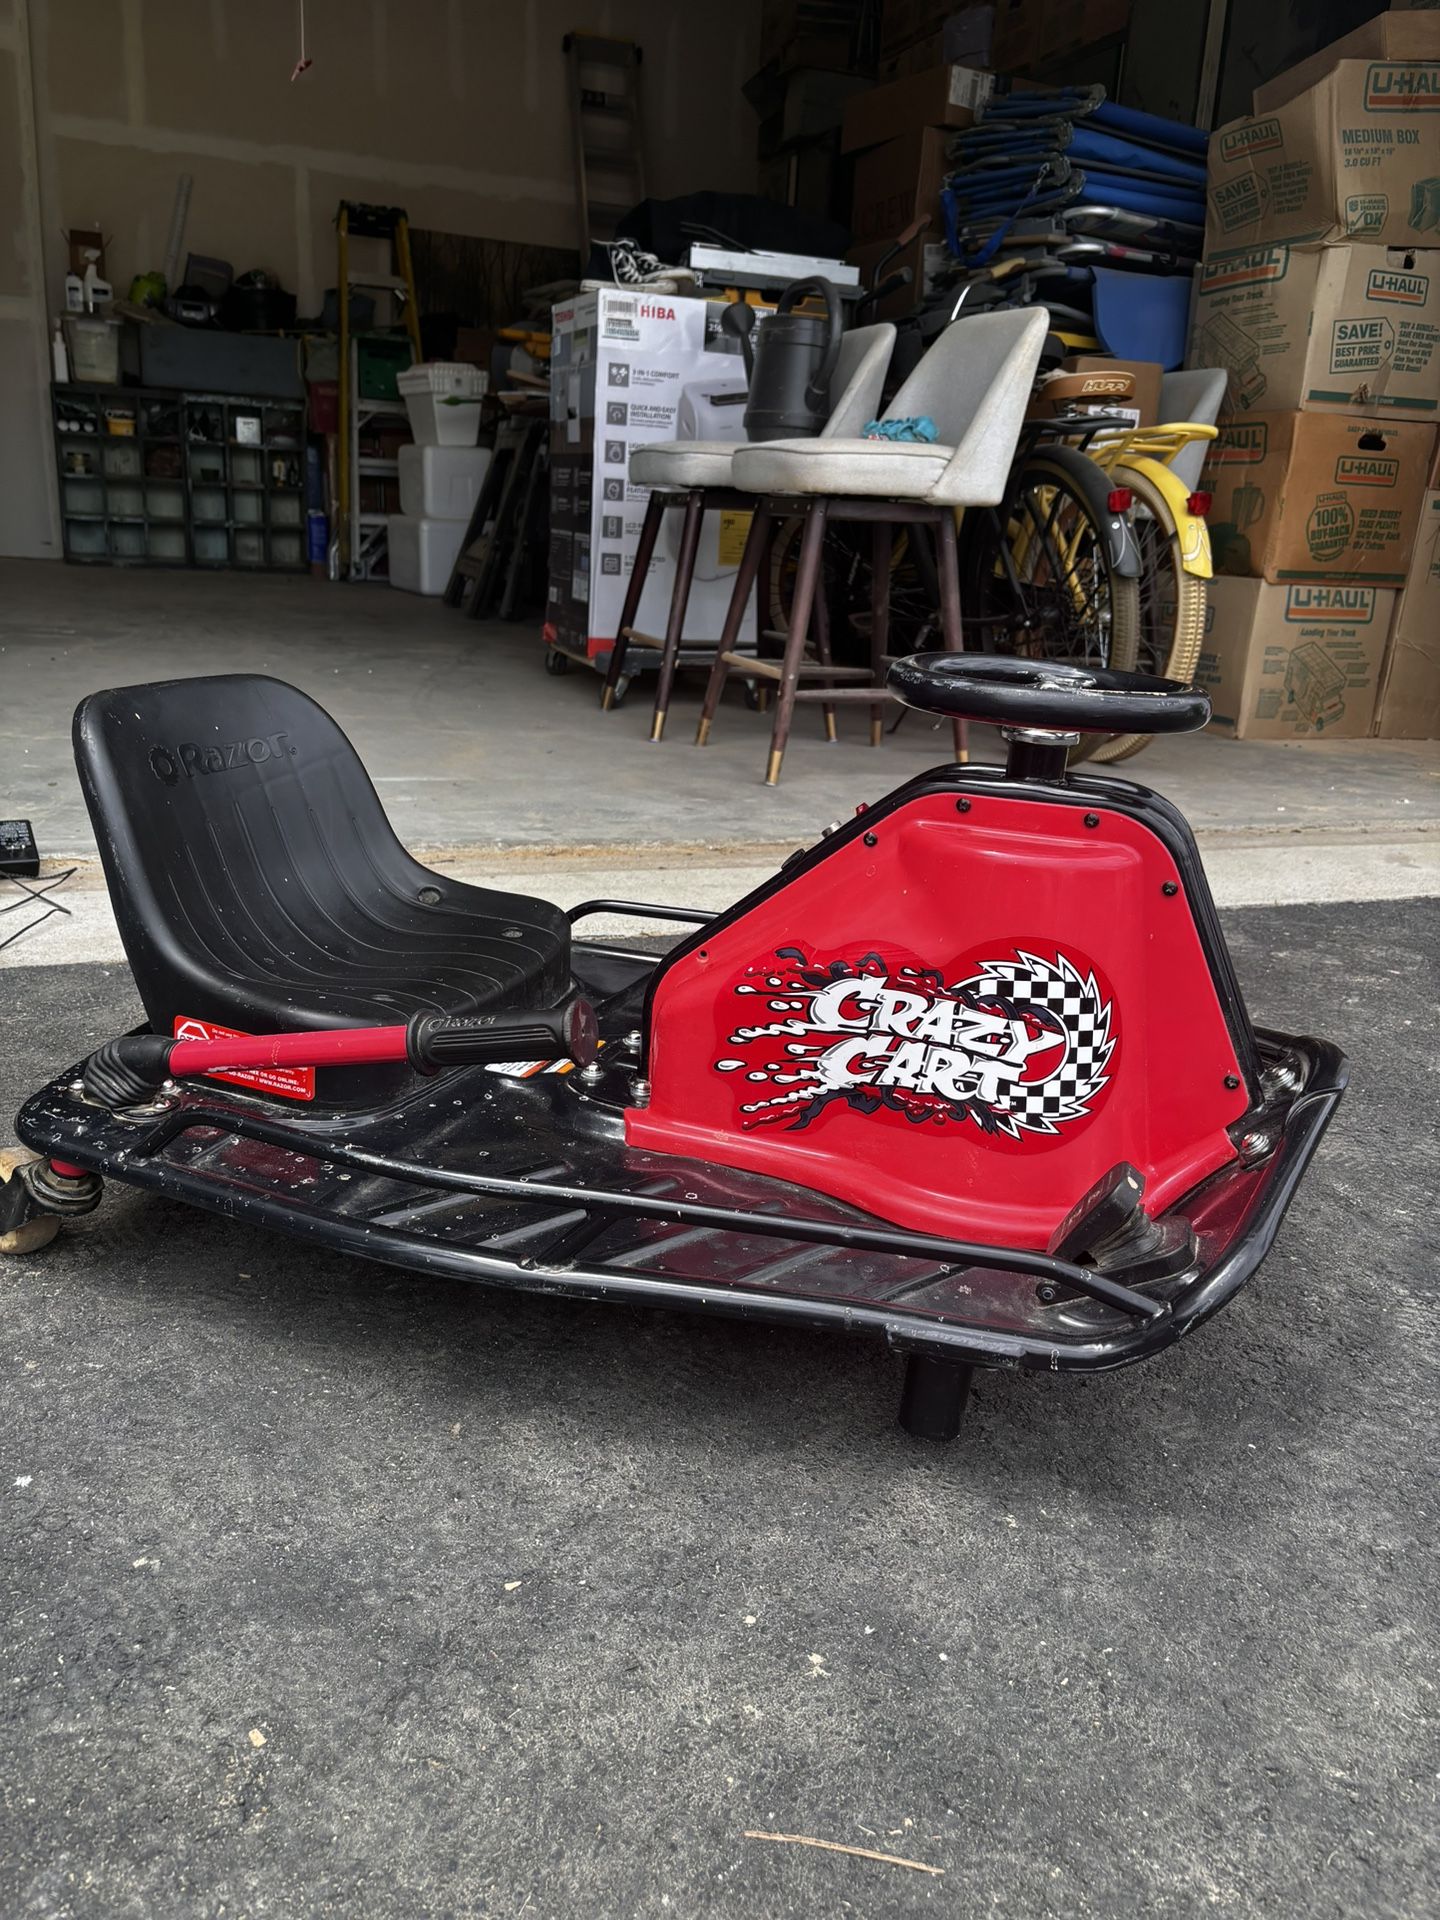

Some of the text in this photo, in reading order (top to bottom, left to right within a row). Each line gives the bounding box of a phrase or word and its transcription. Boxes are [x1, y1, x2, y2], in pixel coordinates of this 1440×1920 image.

[1224, 125, 1277, 150] U-HAUL
[1342, 129, 1420, 144] MEDIUM BOX
[1372, 156, 1381, 166] FT
[1215, 175, 1256, 204] SAVE!
[1364, 212, 1384, 226] OK
[1372, 274, 1425, 295] U-HAUL
[640, 304, 676, 321] HIBA
[1337, 322, 1383, 340] SAVE!
[1336, 344, 1381, 358] BEST PRICE
[1341, 461, 1394, 476] U-HAUL
[1315, 507, 1348, 527] 100%
[1295, 589, 1369, 608] U-HAUL
[807, 973, 1066, 1069] CRAZY
[817, 1036, 1020, 1102] CART
[259, 1077, 306, 1093] WWW.RAZOR.COM
